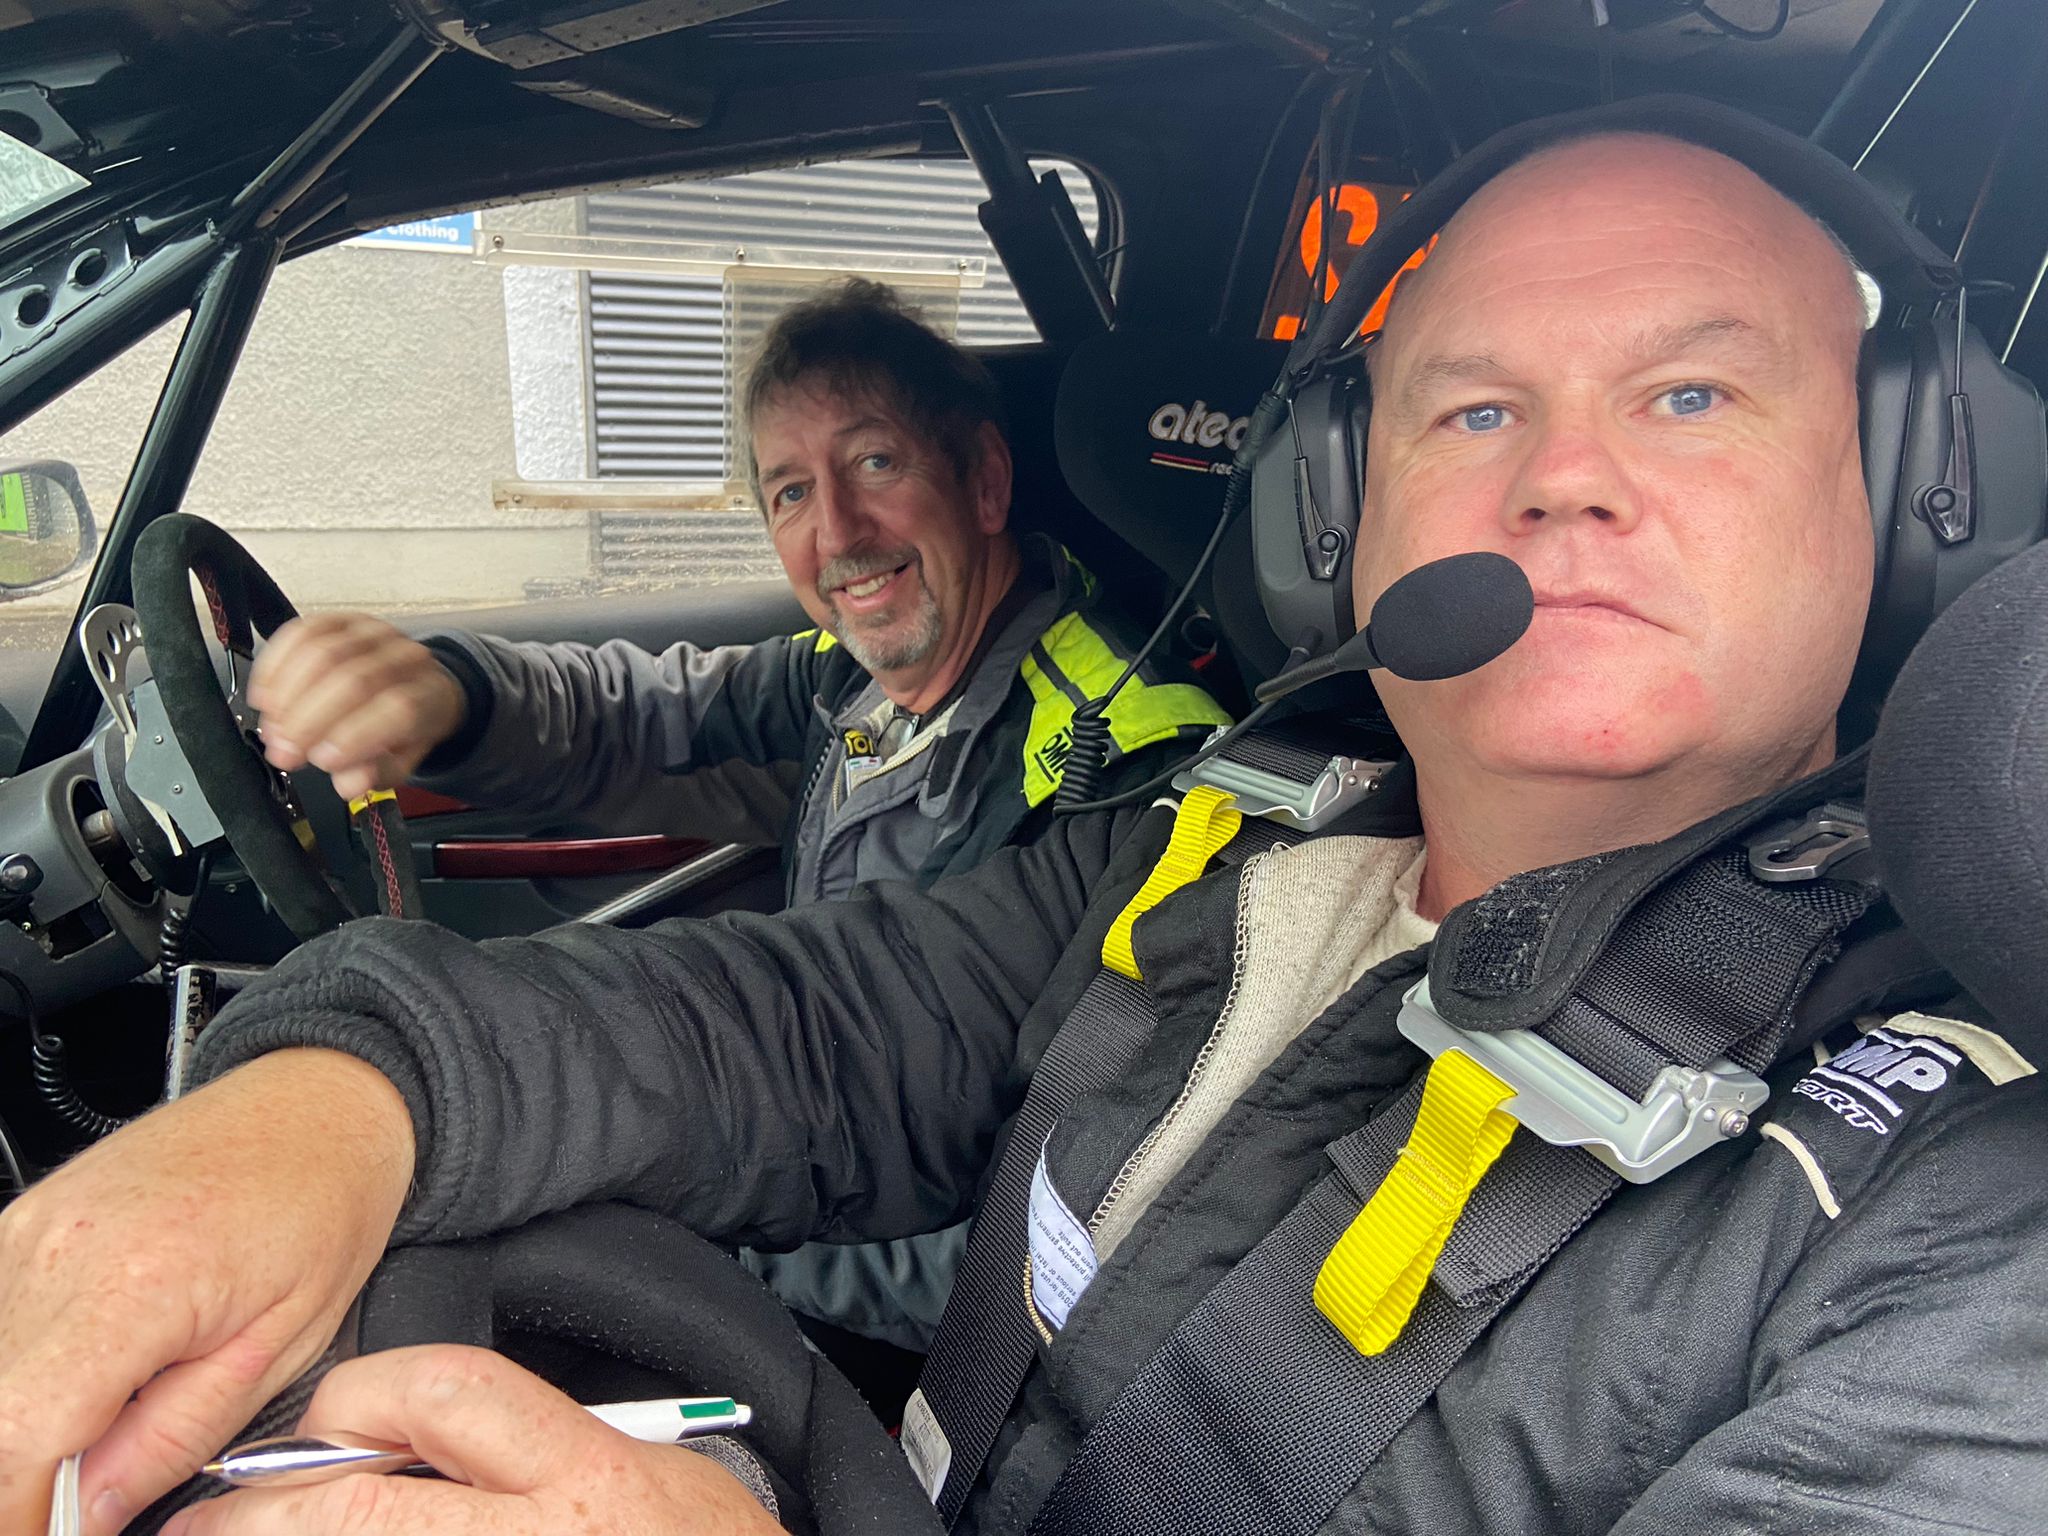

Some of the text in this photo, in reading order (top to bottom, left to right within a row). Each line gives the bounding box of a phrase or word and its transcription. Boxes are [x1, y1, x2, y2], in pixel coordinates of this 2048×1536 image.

[386, 222, 459, 242] Clothing
[1148, 399, 1250, 452] atec
[1792, 1079, 1889, 1135] ORT
